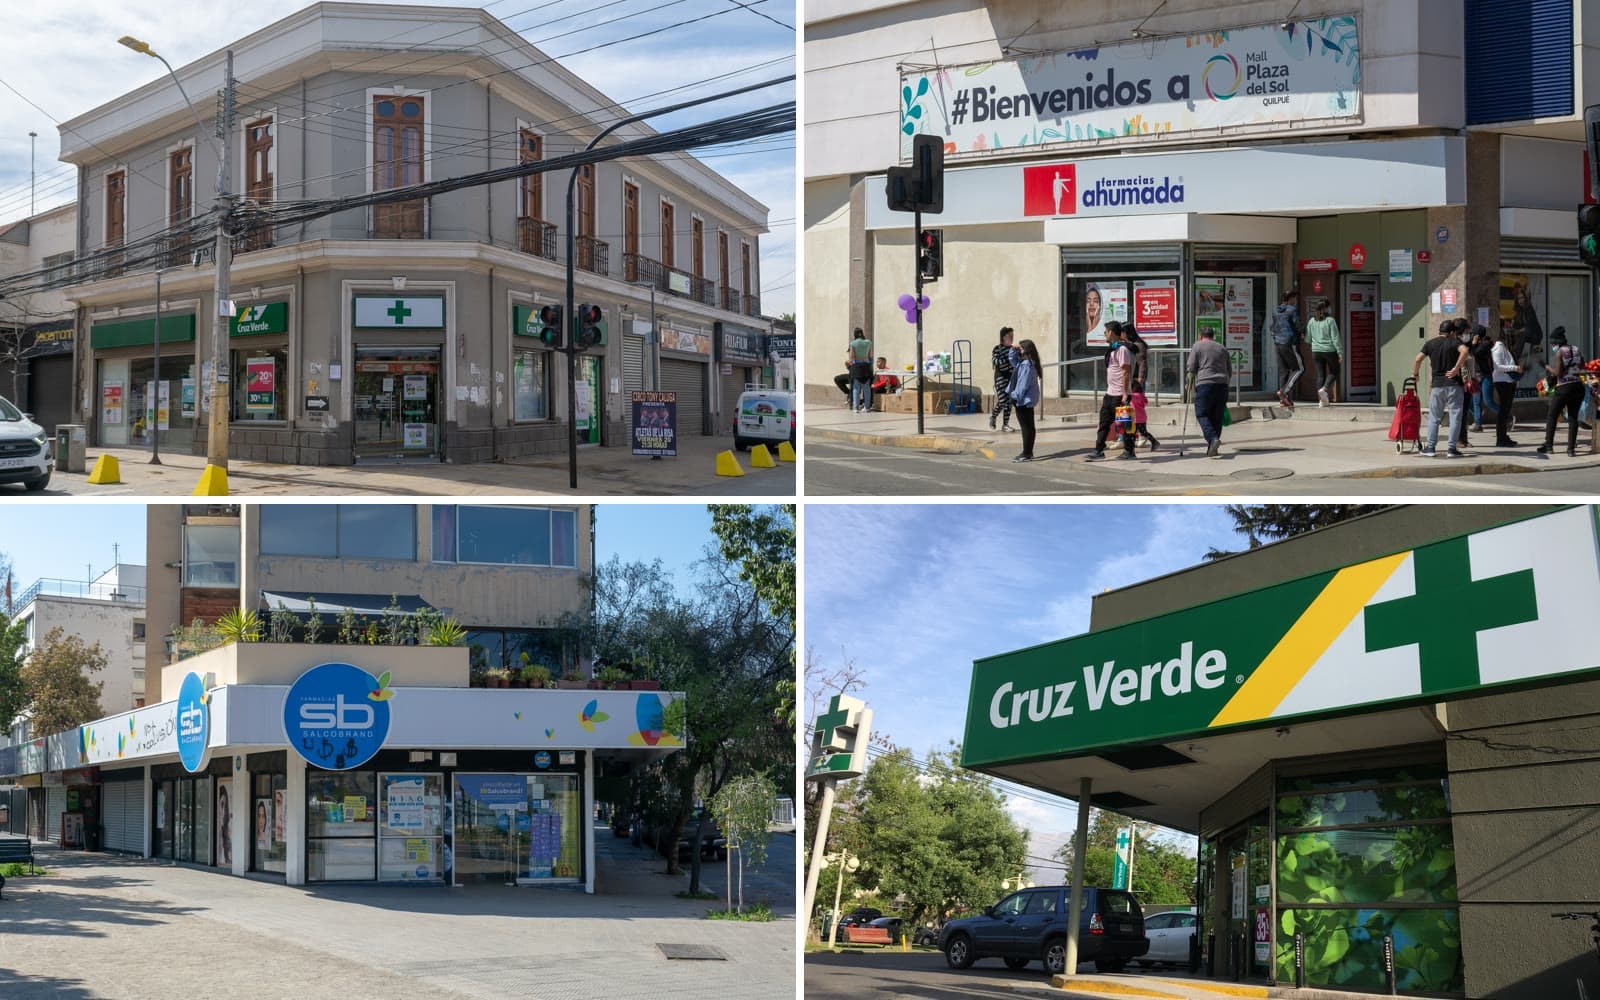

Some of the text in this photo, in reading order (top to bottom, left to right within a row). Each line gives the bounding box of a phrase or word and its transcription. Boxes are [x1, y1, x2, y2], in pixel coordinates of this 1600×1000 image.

[1246, 50, 1268, 62] Mall
[1246, 64, 1290, 80] Plaza
[1246, 79, 1290, 95] del Sol
[951, 68, 1190, 125] #Bienvenidos a
[1102, 175, 1155, 187] farmacias
[1082, 176, 1185, 207] ahumada
[1142, 300, 1150, 315] 3
[237, 321, 269, 333] Cruz Verde
[990, 641, 1227, 728] Cruz Verde
[300, 693, 375, 730] sb
